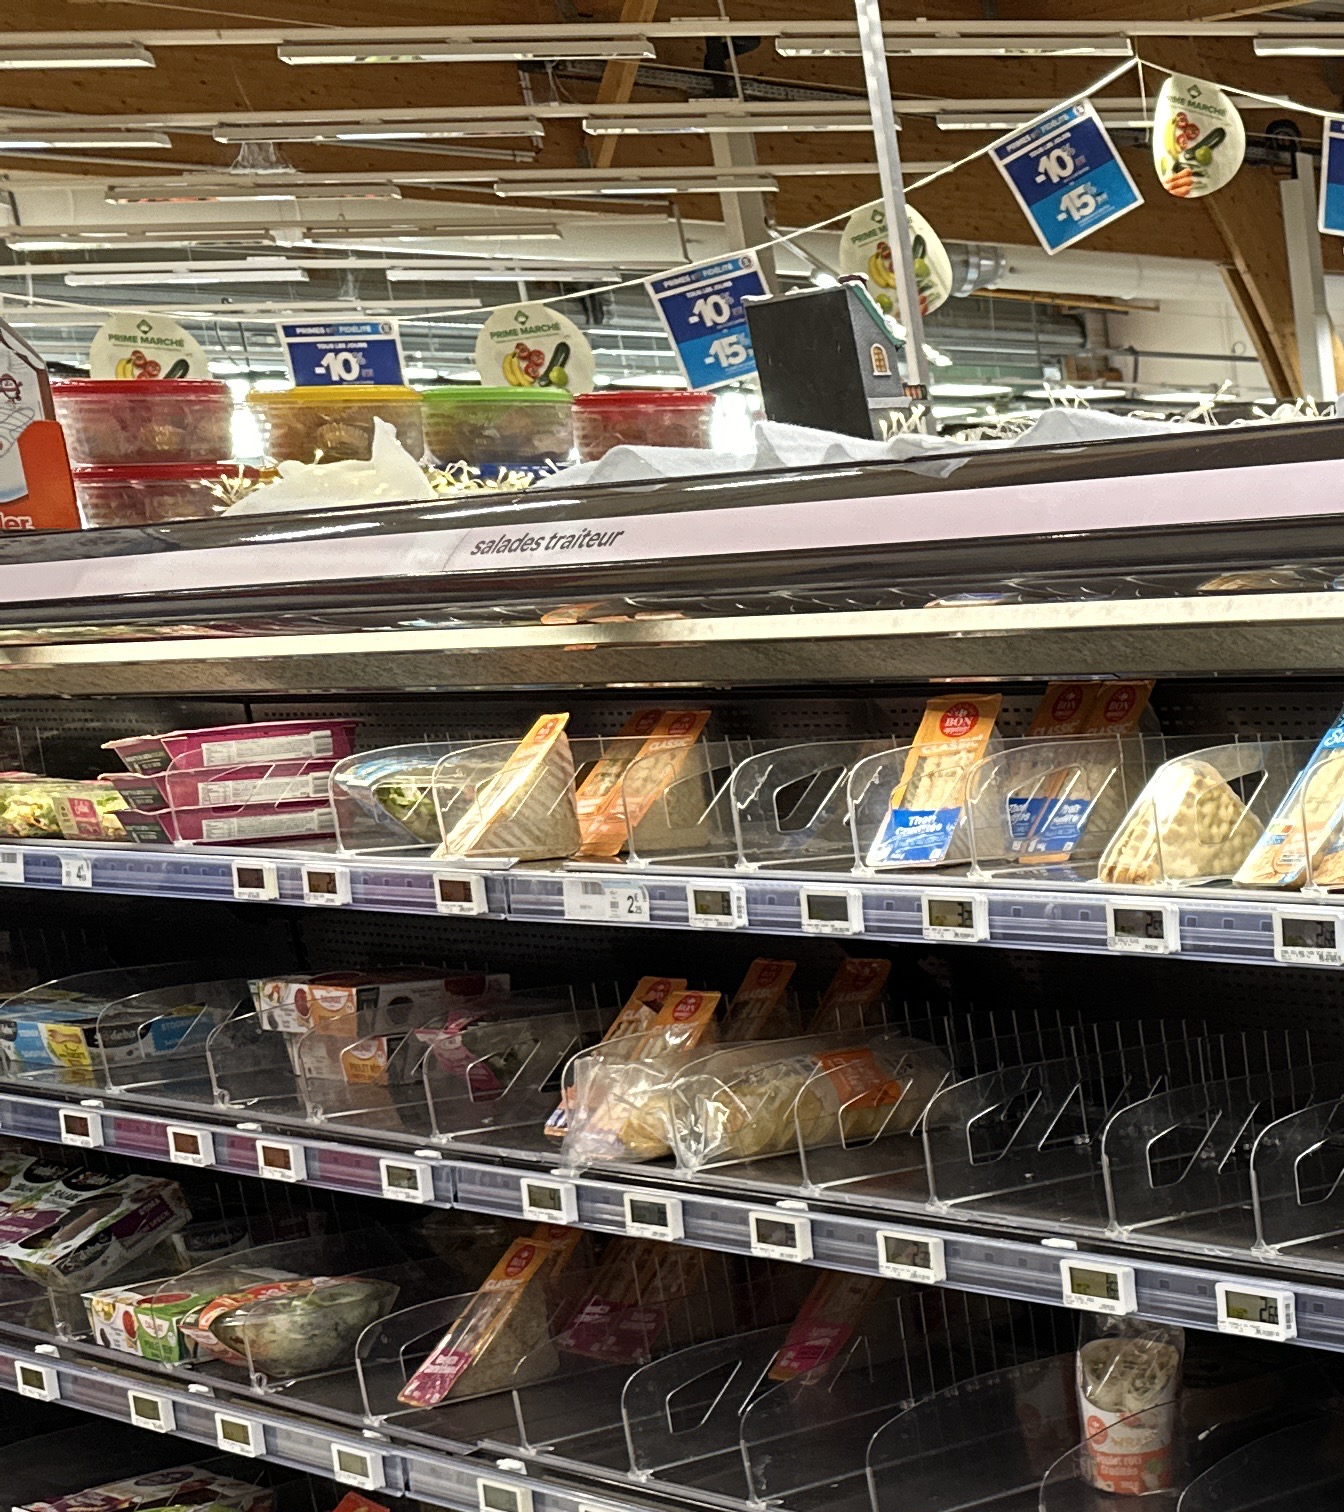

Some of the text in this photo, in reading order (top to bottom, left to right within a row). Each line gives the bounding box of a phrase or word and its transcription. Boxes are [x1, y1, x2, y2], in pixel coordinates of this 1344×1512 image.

[108, 333, 185, 349] PRIME MARCHÉ
[470, 527, 626, 556] salades traiteur
[944, 715, 972, 730] BON
